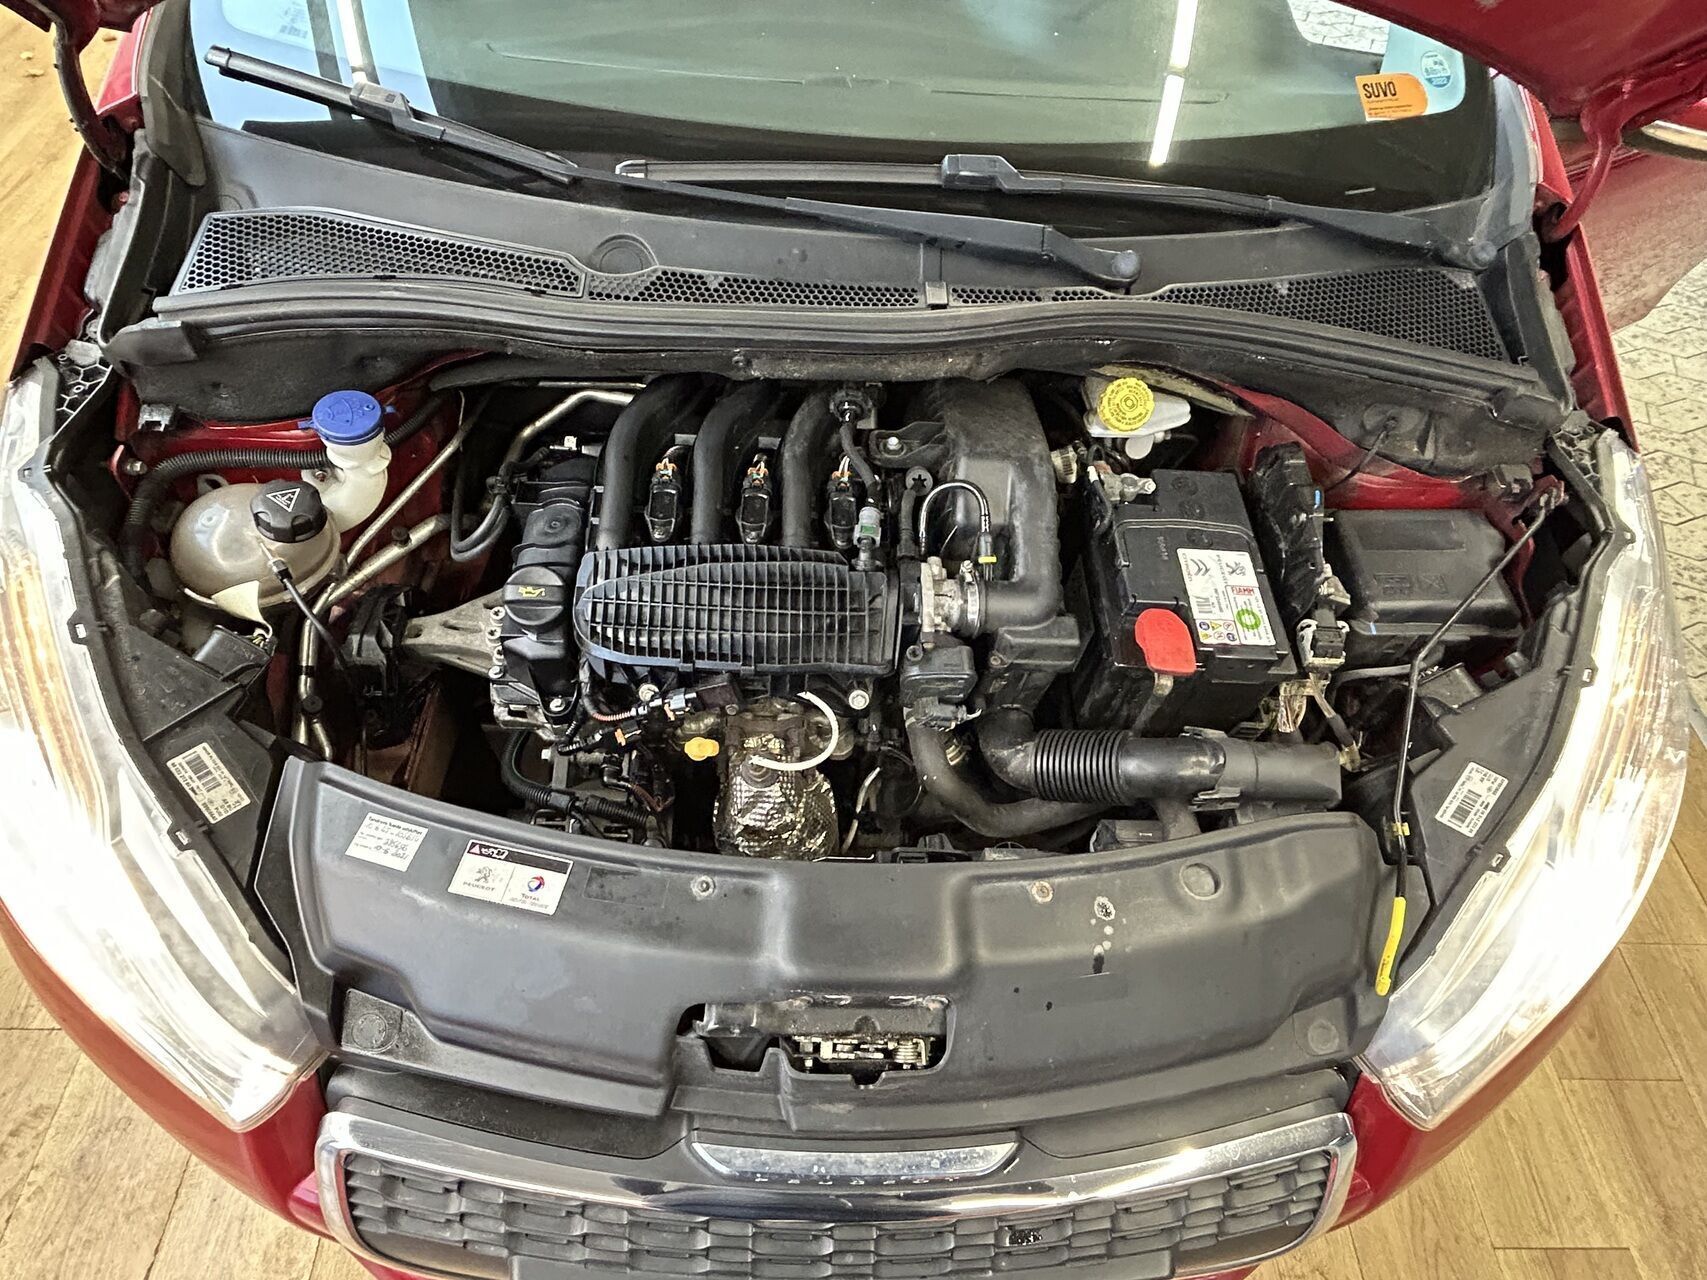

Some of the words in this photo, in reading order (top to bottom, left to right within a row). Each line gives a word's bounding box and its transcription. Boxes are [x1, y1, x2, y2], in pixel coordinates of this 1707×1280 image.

[1362, 81, 1397, 99] SUVO
[1231, 586, 1255, 596] FIAMM
[463, 880, 495, 893] PEUGEOT
[521, 892, 540, 902] TOTAL
